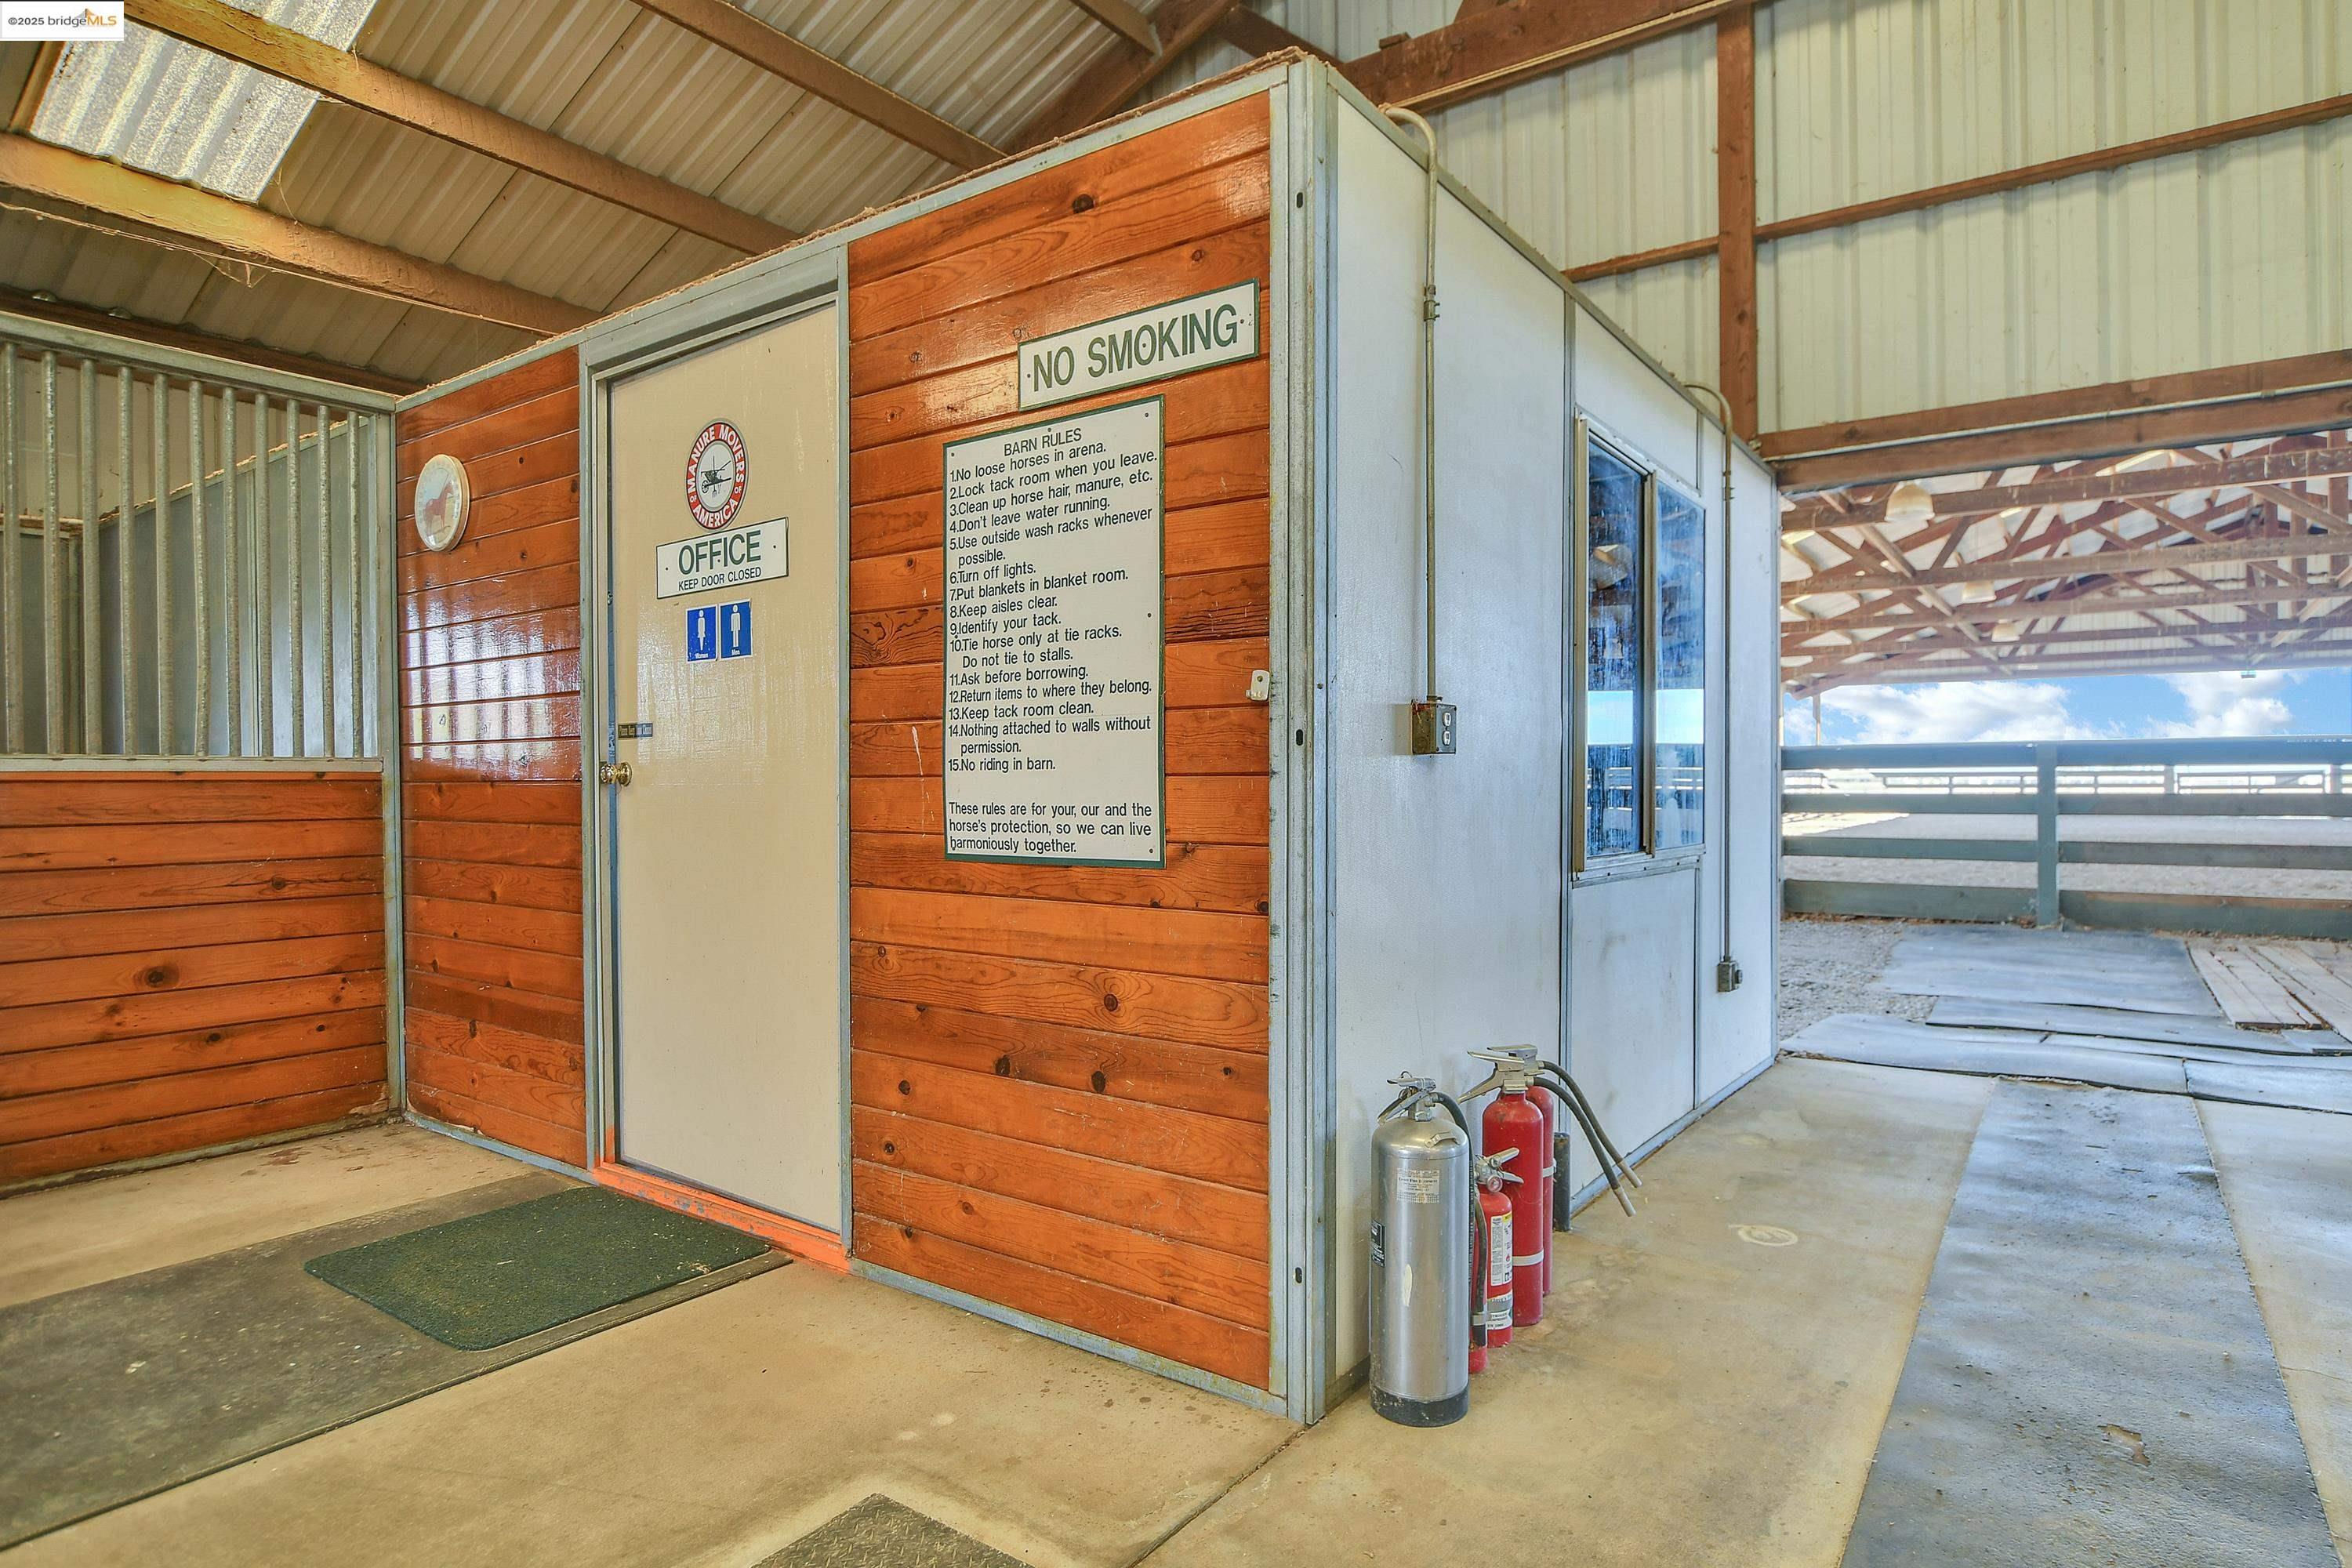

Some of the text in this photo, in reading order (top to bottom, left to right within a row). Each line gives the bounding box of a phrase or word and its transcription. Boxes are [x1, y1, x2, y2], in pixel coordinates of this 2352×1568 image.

[1034, 304, 1237, 391] NO SMOKING
[1004, 428, 1081, 456] BARN RULES
[688, 424, 745, 494] MANURE MOVERS
[975, 463, 1005, 477] loose
[1011, 452, 1049, 470] horses
[1054, 449, 1063, 461] in
[1069, 442, 1105, 458] arena.
[990, 477, 1014, 492] tack
[1020, 471, 1050, 487] room
[1055, 463, 1087, 479] when
[1093, 459, 1115, 474] you
[1120, 450, 1156, 466] leave.
[993, 497, 1006, 512] up
[1011, 488, 1043, 506] horse
[1048, 484, 1070, 499] hair,
[1076, 477, 1123, 494] manure,
[1129, 470, 1152, 483] etc.
[693, 499, 738, 527] AMERICA
[991, 511, 1020, 526] leave
[1026, 505, 1058, 521] water
[1064, 496, 1110, 515] running.
[982, 528, 1020, 546] outside
[1025, 523, 1053, 539] wash
[1058, 517, 1088, 534] racks
[1094, 507, 1152, 527] whenever
[679, 530, 761, 575] OFFICE
[958, 550, 1005, 568] possible.
[678, 567, 761, 591] KEEP DOOR CLOSED
[983, 565, 999, 580] off
[1004, 561, 1036, 578] lights.
[979, 580, 1025, 597] blankets
[1030, 579, 1039, 591] in
[1044, 571, 1087, 589] blanket
[1092, 568, 1127, 582] room.
[992, 599, 1022, 613] aisles
[1028, 596, 1057, 608] clear.
[1004, 618, 1027, 632] your
[1033, 613, 1061, 626] tack.
[983, 636, 1014, 649] horse
[1019, 632, 1041, 647] only
[1047, 630, 1058, 642] at
[1065, 628, 1079, 641] tie
[1084, 625, 1121, 639] racks.
[963, 647, 1073, 668] Do not tie to stalls.
[985, 669, 1021, 683] before
[1026, 665, 1087, 680] borrowing.
[995, 687, 1022, 700] items
[1027, 686, 1037, 698] to
[1043, 682, 1075, 696] where
[1081, 680, 1104, 696] they
[1109, 680, 1151, 695] belong.
[994, 705, 1018, 717] tack
[1023, 705, 1054, 716] room
[1059, 702, 1094, 714] clean.
[1003, 719, 1050, 735] attached
[1056, 720, 1066, 732] to
[1073, 718, 1099, 731] walls
[1105, 717, 1151, 731] without
[961, 740, 1021, 756] permission.
[980, 757, 1008, 772] riding
[1013, 757, 1022, 769] in
[1027, 757, 1055, 769] barn.
[949, 802, 1152, 818] These rules are for your, our and the
[949, 819, 1151, 835] horse's protection, so we can live
[950, 837, 1076, 854] harmoniously together.
